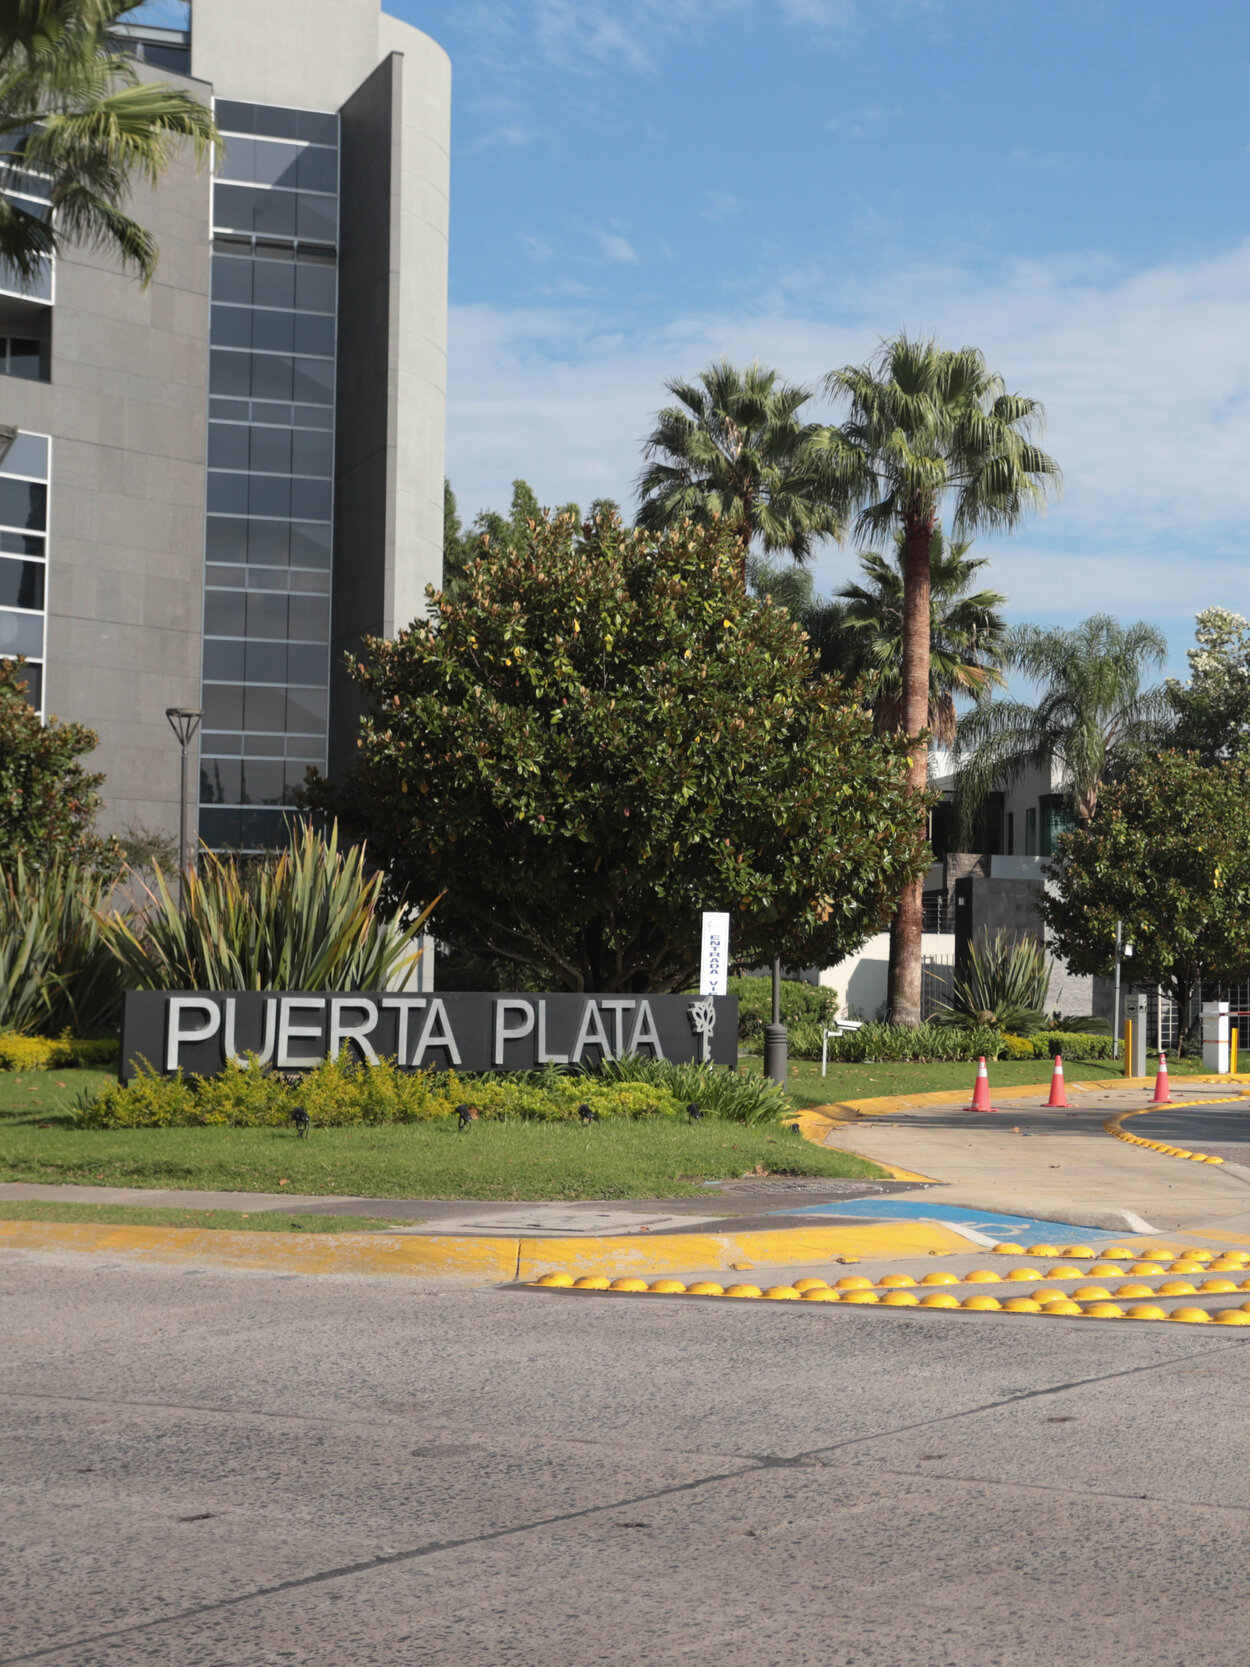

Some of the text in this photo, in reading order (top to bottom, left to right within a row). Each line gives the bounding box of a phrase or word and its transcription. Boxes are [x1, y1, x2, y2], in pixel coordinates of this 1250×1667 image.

[709, 934, 720, 975] ENTRADA
[166, 997, 665, 1070] PUERTA PLATA
